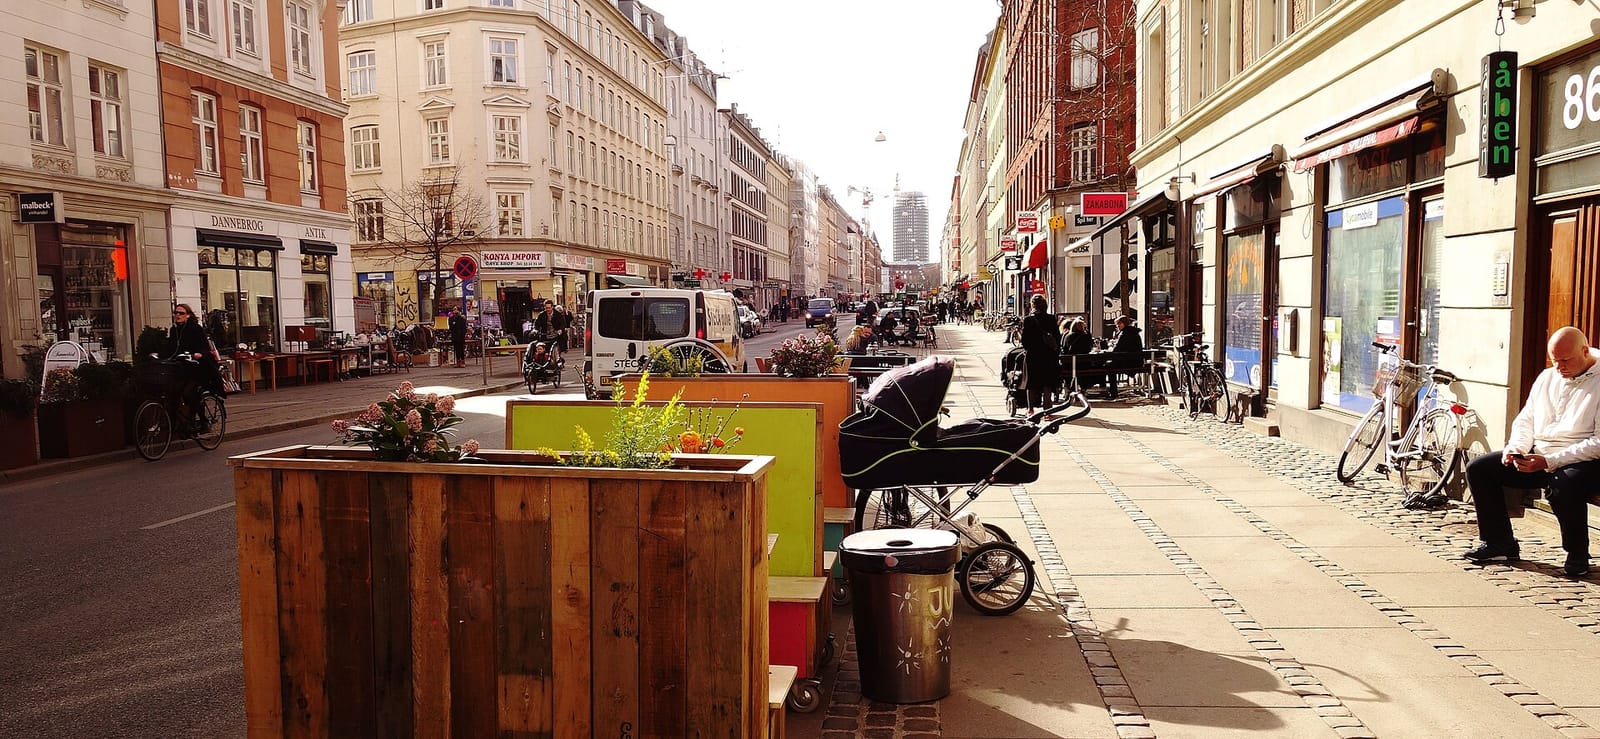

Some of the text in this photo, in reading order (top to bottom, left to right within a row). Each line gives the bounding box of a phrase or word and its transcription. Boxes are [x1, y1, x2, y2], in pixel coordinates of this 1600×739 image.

[1563, 64, 1600, 130] 86
[1493, 60, 1512, 165] åben
[211, 215, 264, 231] DANNEBROG
[304, 227, 327, 239] ANTIK
[483, 253, 542, 261] KONYA IMPORT
[614, 359, 641, 368] STEC
